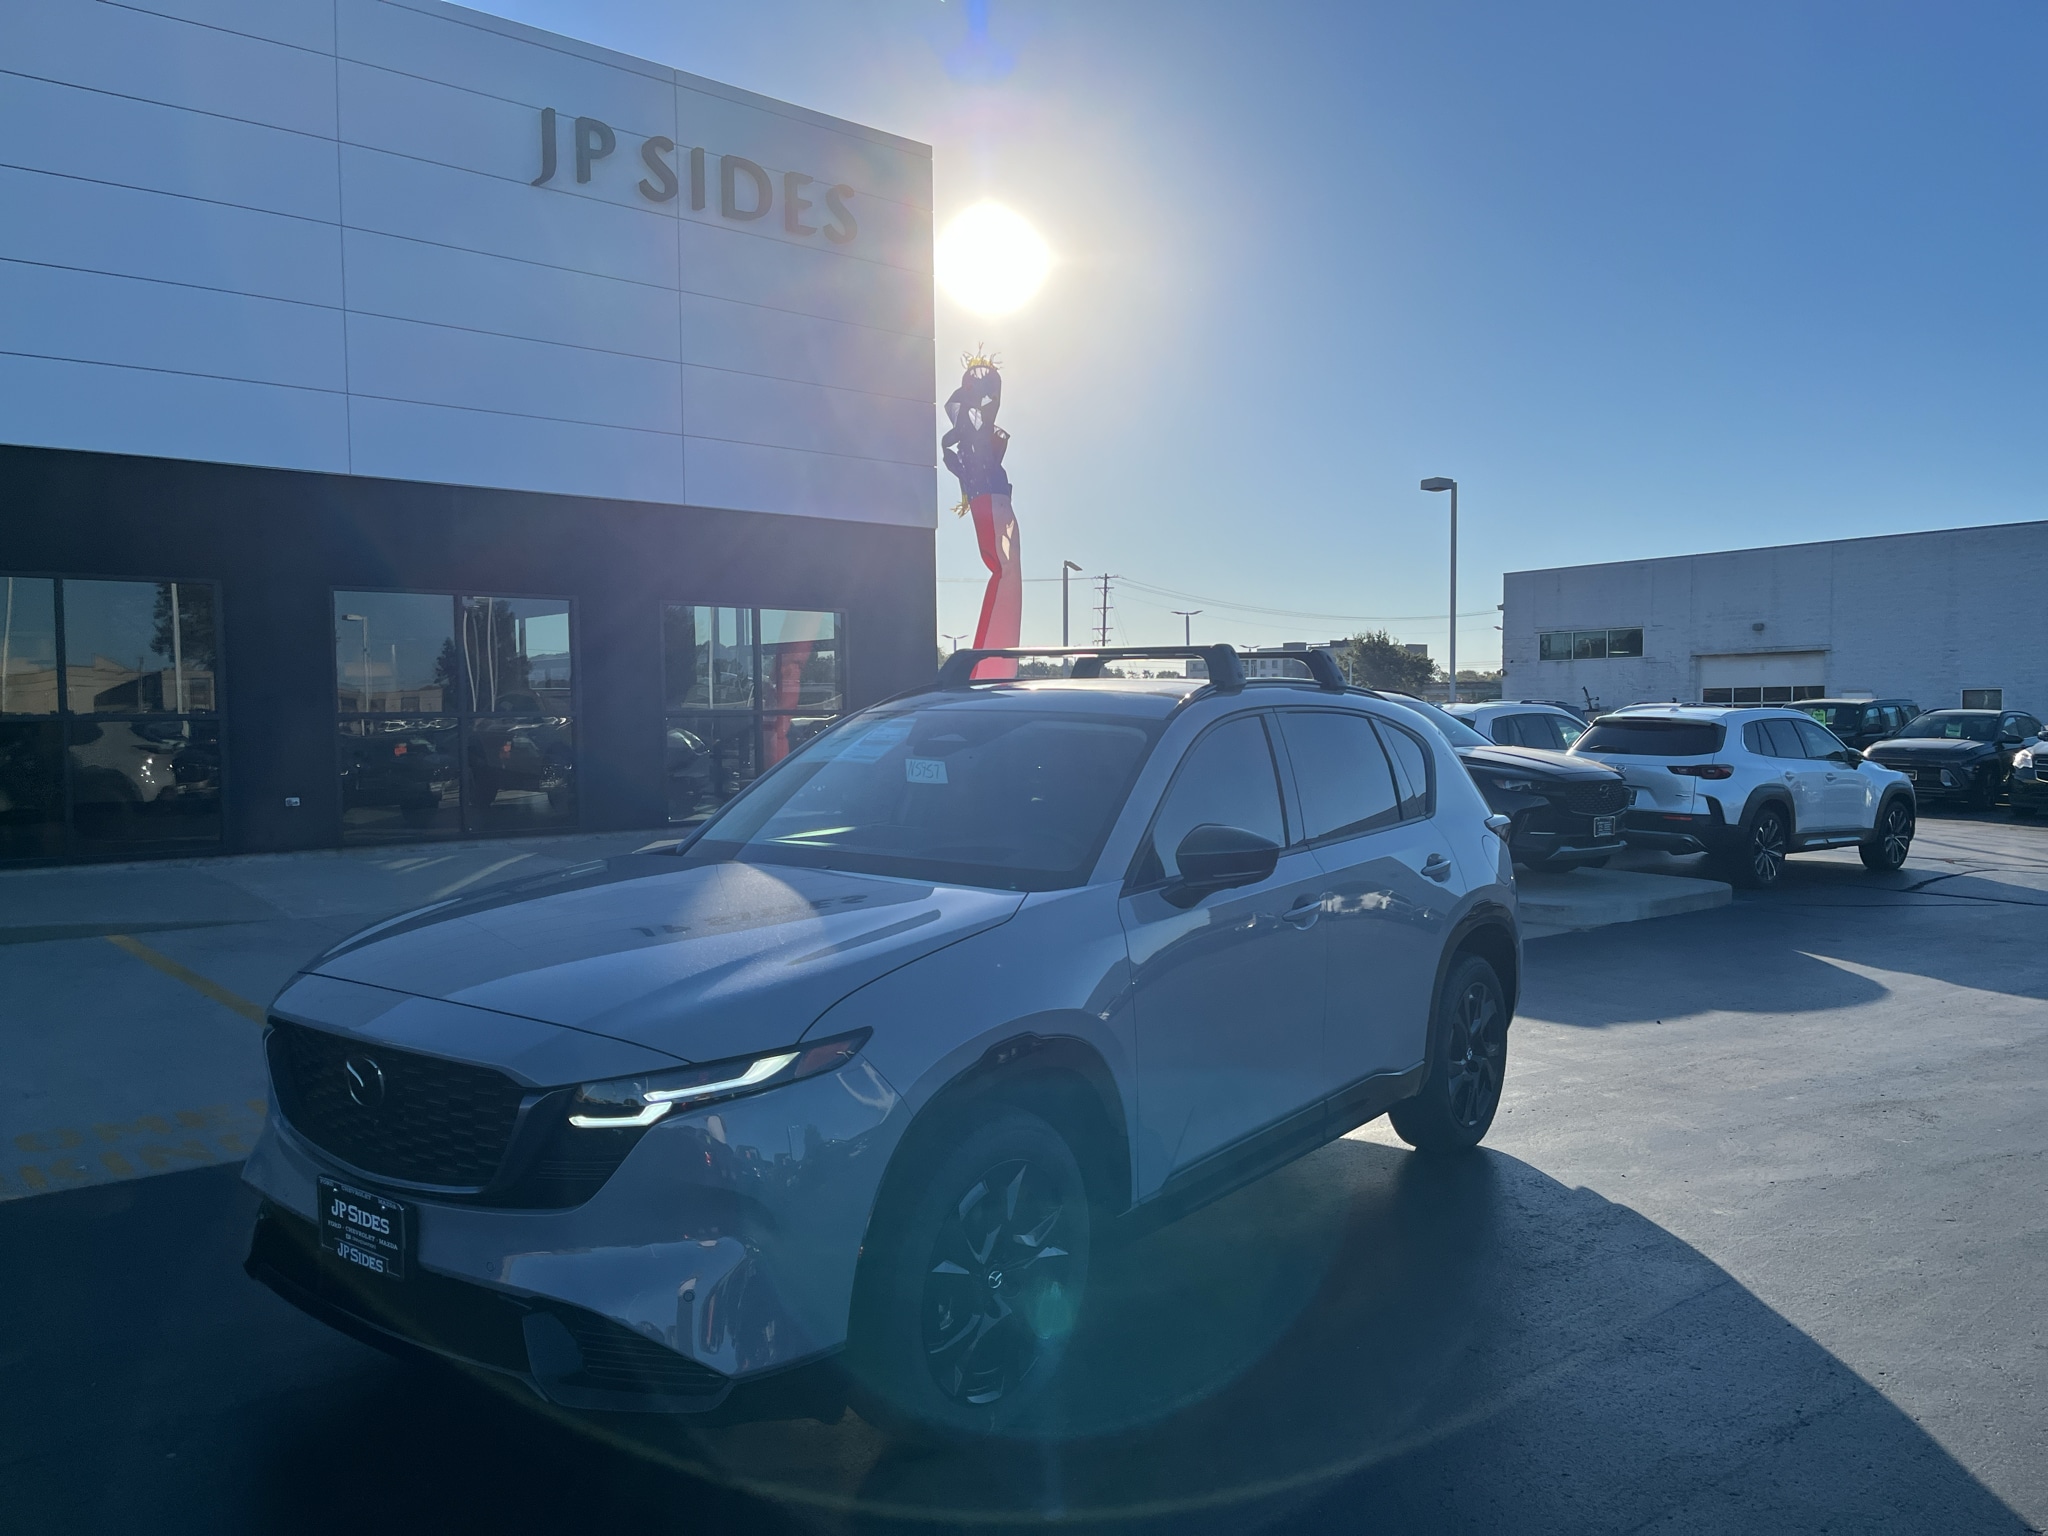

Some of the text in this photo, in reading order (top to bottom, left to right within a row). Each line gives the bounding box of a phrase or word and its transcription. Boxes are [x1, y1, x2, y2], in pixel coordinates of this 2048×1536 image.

[531, 106, 858, 244] JP SIDES
[341, 1186, 372, 1200] CHEVROLET
[378, 1199, 397, 1210] MAZDA
[331, 1199, 390, 1234] JP SIDES
[328, 1220, 342, 1229] FORD
[345, 1226, 376, 1241] CHEVROLET
[379, 1239, 398, 1250] MAZDA
[337, 1242, 384, 1273] JP SIDES
